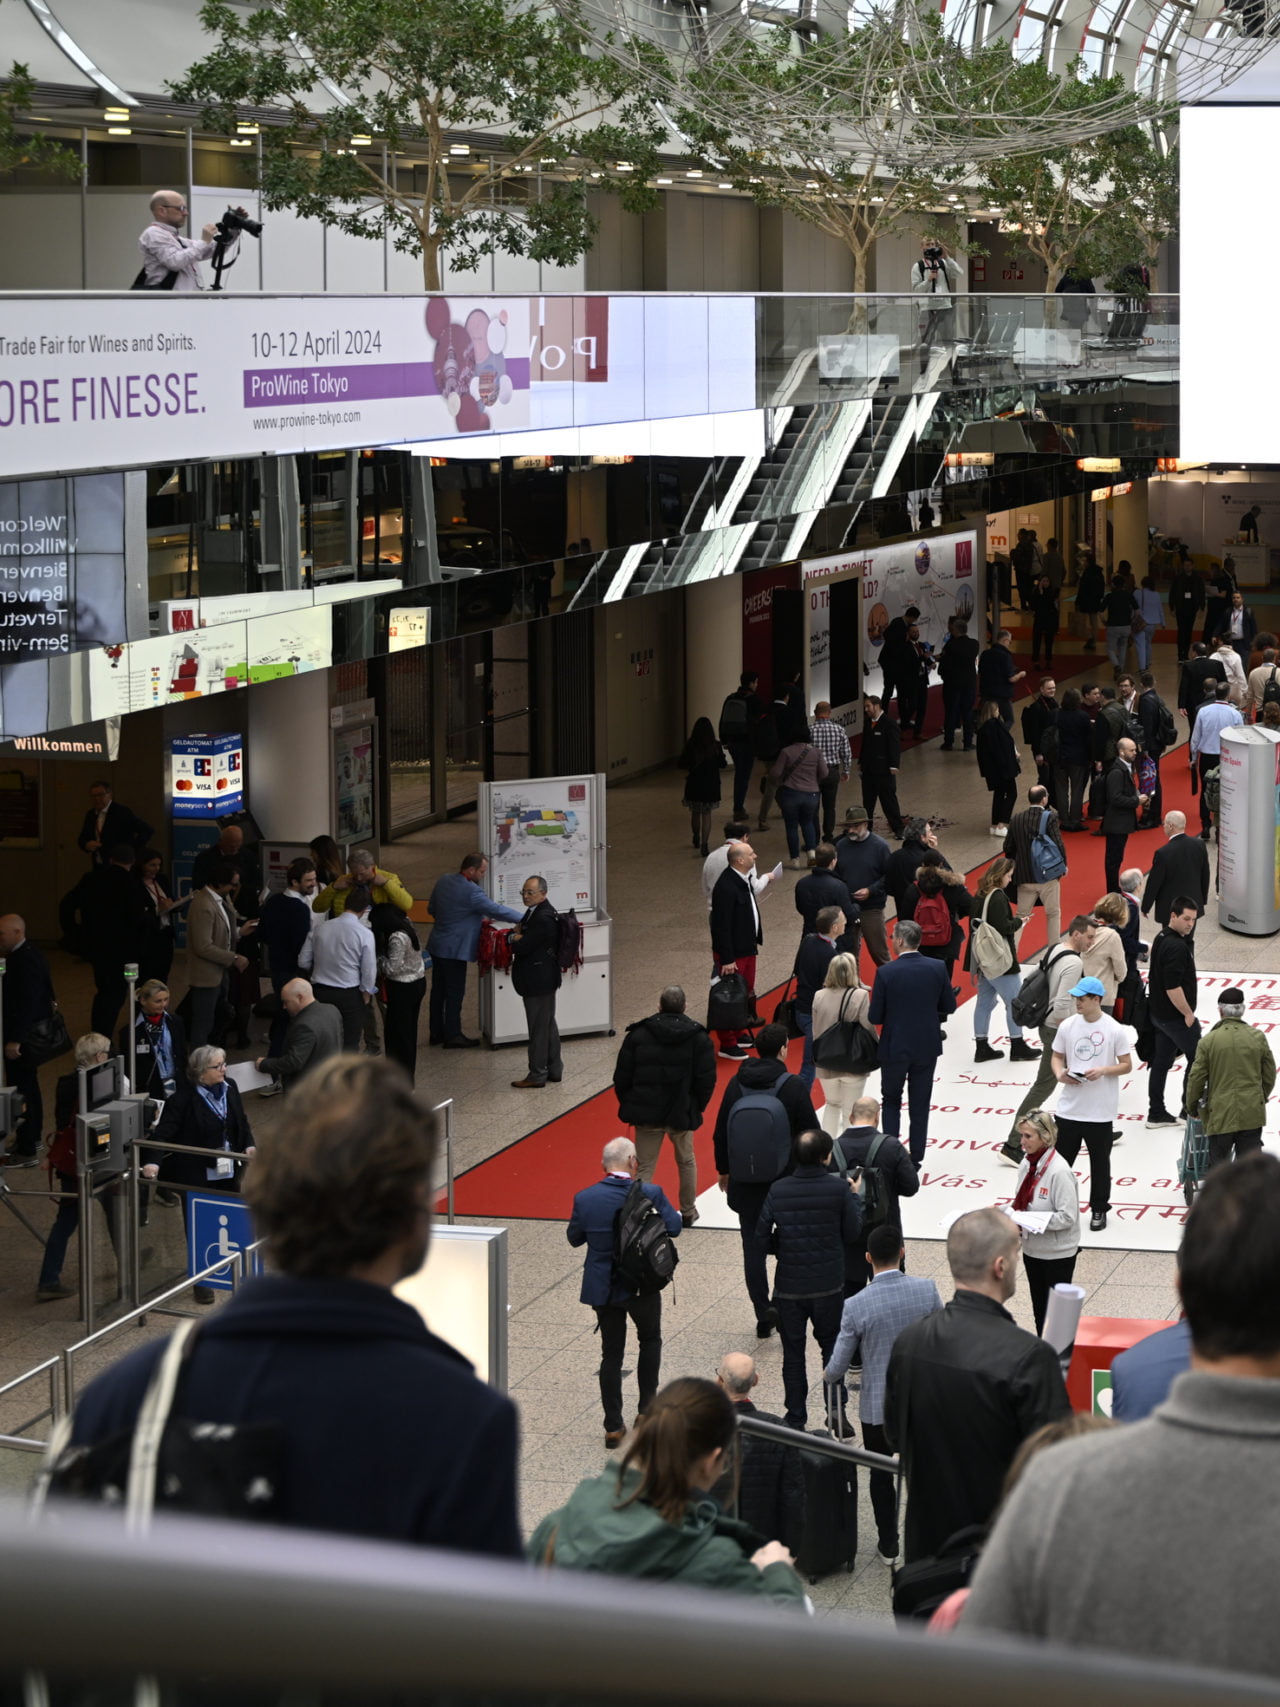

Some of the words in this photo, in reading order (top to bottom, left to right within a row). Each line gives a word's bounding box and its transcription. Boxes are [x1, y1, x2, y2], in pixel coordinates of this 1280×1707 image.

[0, 336, 36, 357] Trade
[40, 336, 65, 355] Fair
[68, 335, 85, 354] for
[89, 334, 128, 353] Wines
[132, 333, 153, 352] and
[157, 333, 197, 356] Spirits.
[251, 331, 298, 358] 10-12
[303, 329, 340, 362] April
[345, 329, 382, 355] 2024
[71, 372, 206, 422] FINESSE.
[251, 374, 309, 398] ProWine
[311, 371, 349, 398] Tokyo
[253, 408, 362, 431] www.prowine-tokyo.com
[13, 736, 102, 753] Willkommen
